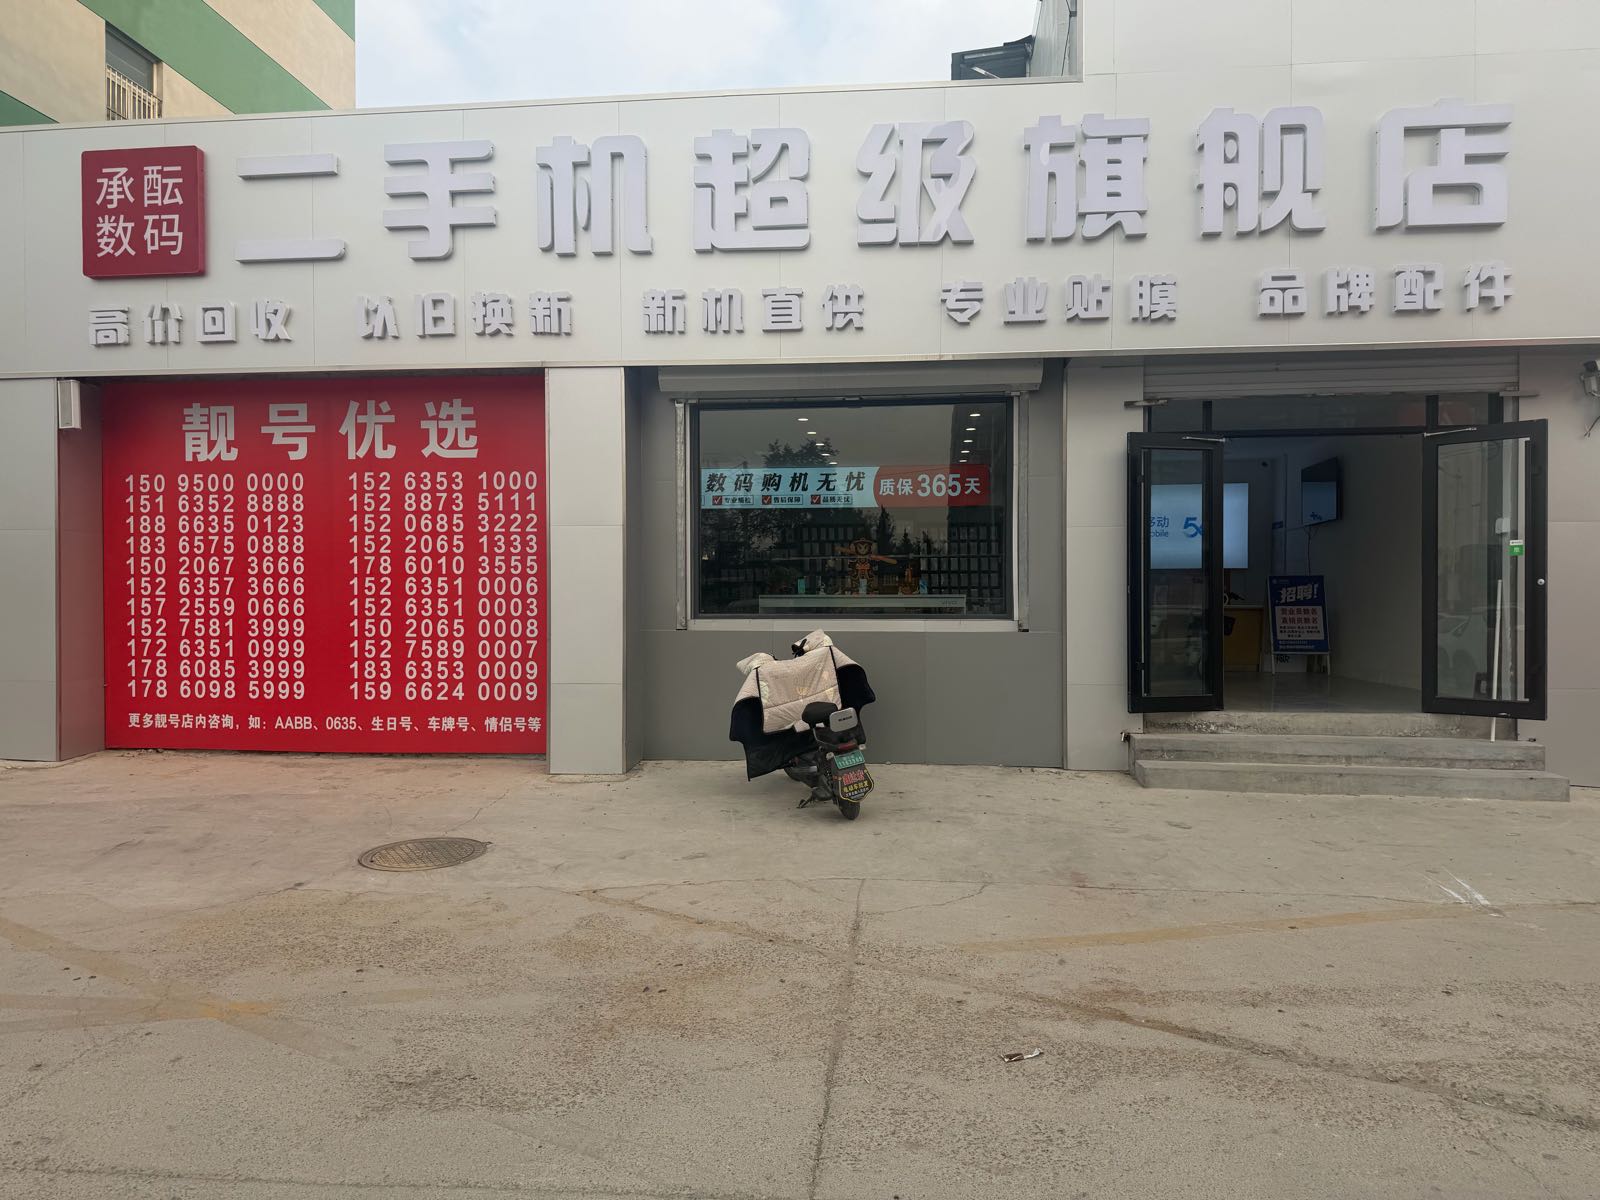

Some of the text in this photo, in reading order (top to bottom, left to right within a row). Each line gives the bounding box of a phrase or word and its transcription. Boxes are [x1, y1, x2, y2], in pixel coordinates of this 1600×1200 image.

[96, 165, 184, 209] 承酝
[235, 97, 1514, 262] 二手机超级旗舰店
[96, 213, 184, 258] 数码
[88, 262, 1513, 347] 高价回收 以旧换新 新机直供 专业贴膜 品牌配件
[182, 398, 479, 462] 靓号优选
[125, 472, 304, 493] 150 9500 0000
[348, 470, 538, 491] 152 6353 1000
[705, 472, 981, 496] 数码购机无忧 质保365天
[125, 493, 305, 513] 151 6352 8888
[348, 492, 535, 512] 152 8873 5111
[125, 514, 304, 534] 188 6635 0123
[348, 512, 538, 533] 152 0685 3222
[126, 534, 305, 555] 183 6575 0888
[349, 534, 538, 554] 152 2065 1333
[126, 555, 305, 575] 150 2067 3666
[349, 555, 538, 575] 178 6010 3555
[126, 576, 305, 596] 152 6357 3666
[349, 576, 538, 596] 152 6351 0006
[126, 597, 305, 617] 157 2559 0666
[349, 597, 538, 617] 152 6351 0003
[127, 618, 305, 638] 152 7581 3999
[349, 618, 539, 638] 150 2065 0008
[127, 638, 305, 659] 172 6351 0999
[349, 639, 538, 659] 152 7589 0007
[127, 658, 305, 679] 178 6085 3999
[349, 660, 538, 680] 183 6353 0009
[127, 679, 305, 700] 178 6098 5999
[349, 681, 538, 701] 159 6624 0009
